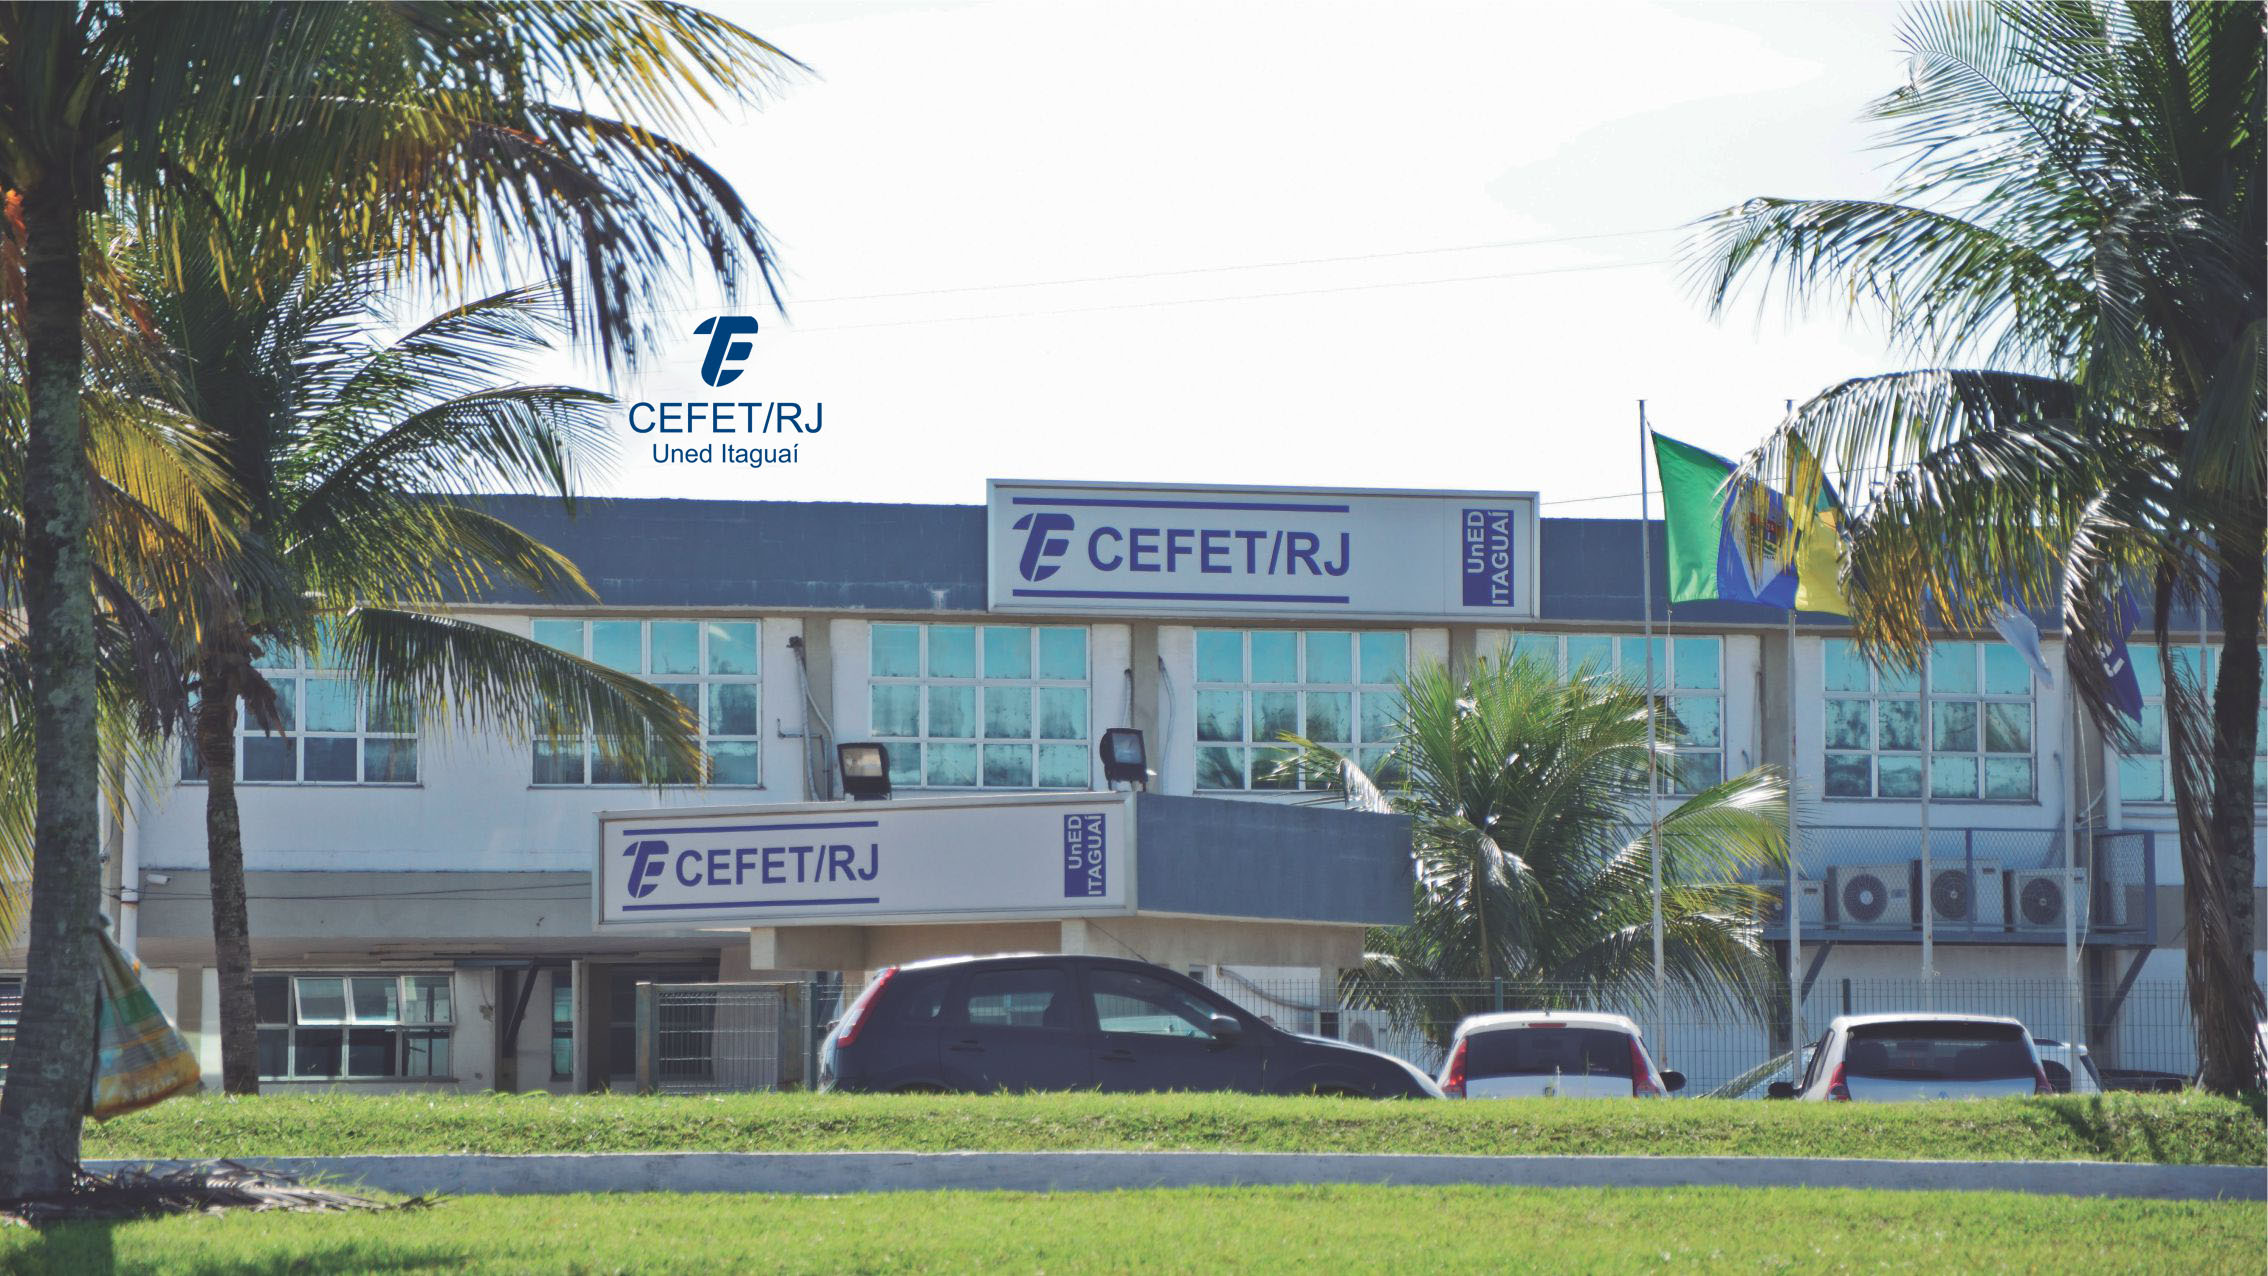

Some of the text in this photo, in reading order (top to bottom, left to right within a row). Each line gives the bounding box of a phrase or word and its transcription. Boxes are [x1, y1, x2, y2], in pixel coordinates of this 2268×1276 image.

[1087, 525, 1351, 577] CEFET/RJ
[1467, 510, 1485, 574] UnED
[1487, 510, 1509, 605] ITAGUAÍ
[675, 843, 879, 888] CEFET/RJ
[1068, 815, 1082, 870] UnED
[1085, 815, 1102, 895] ITAGUAÍ
